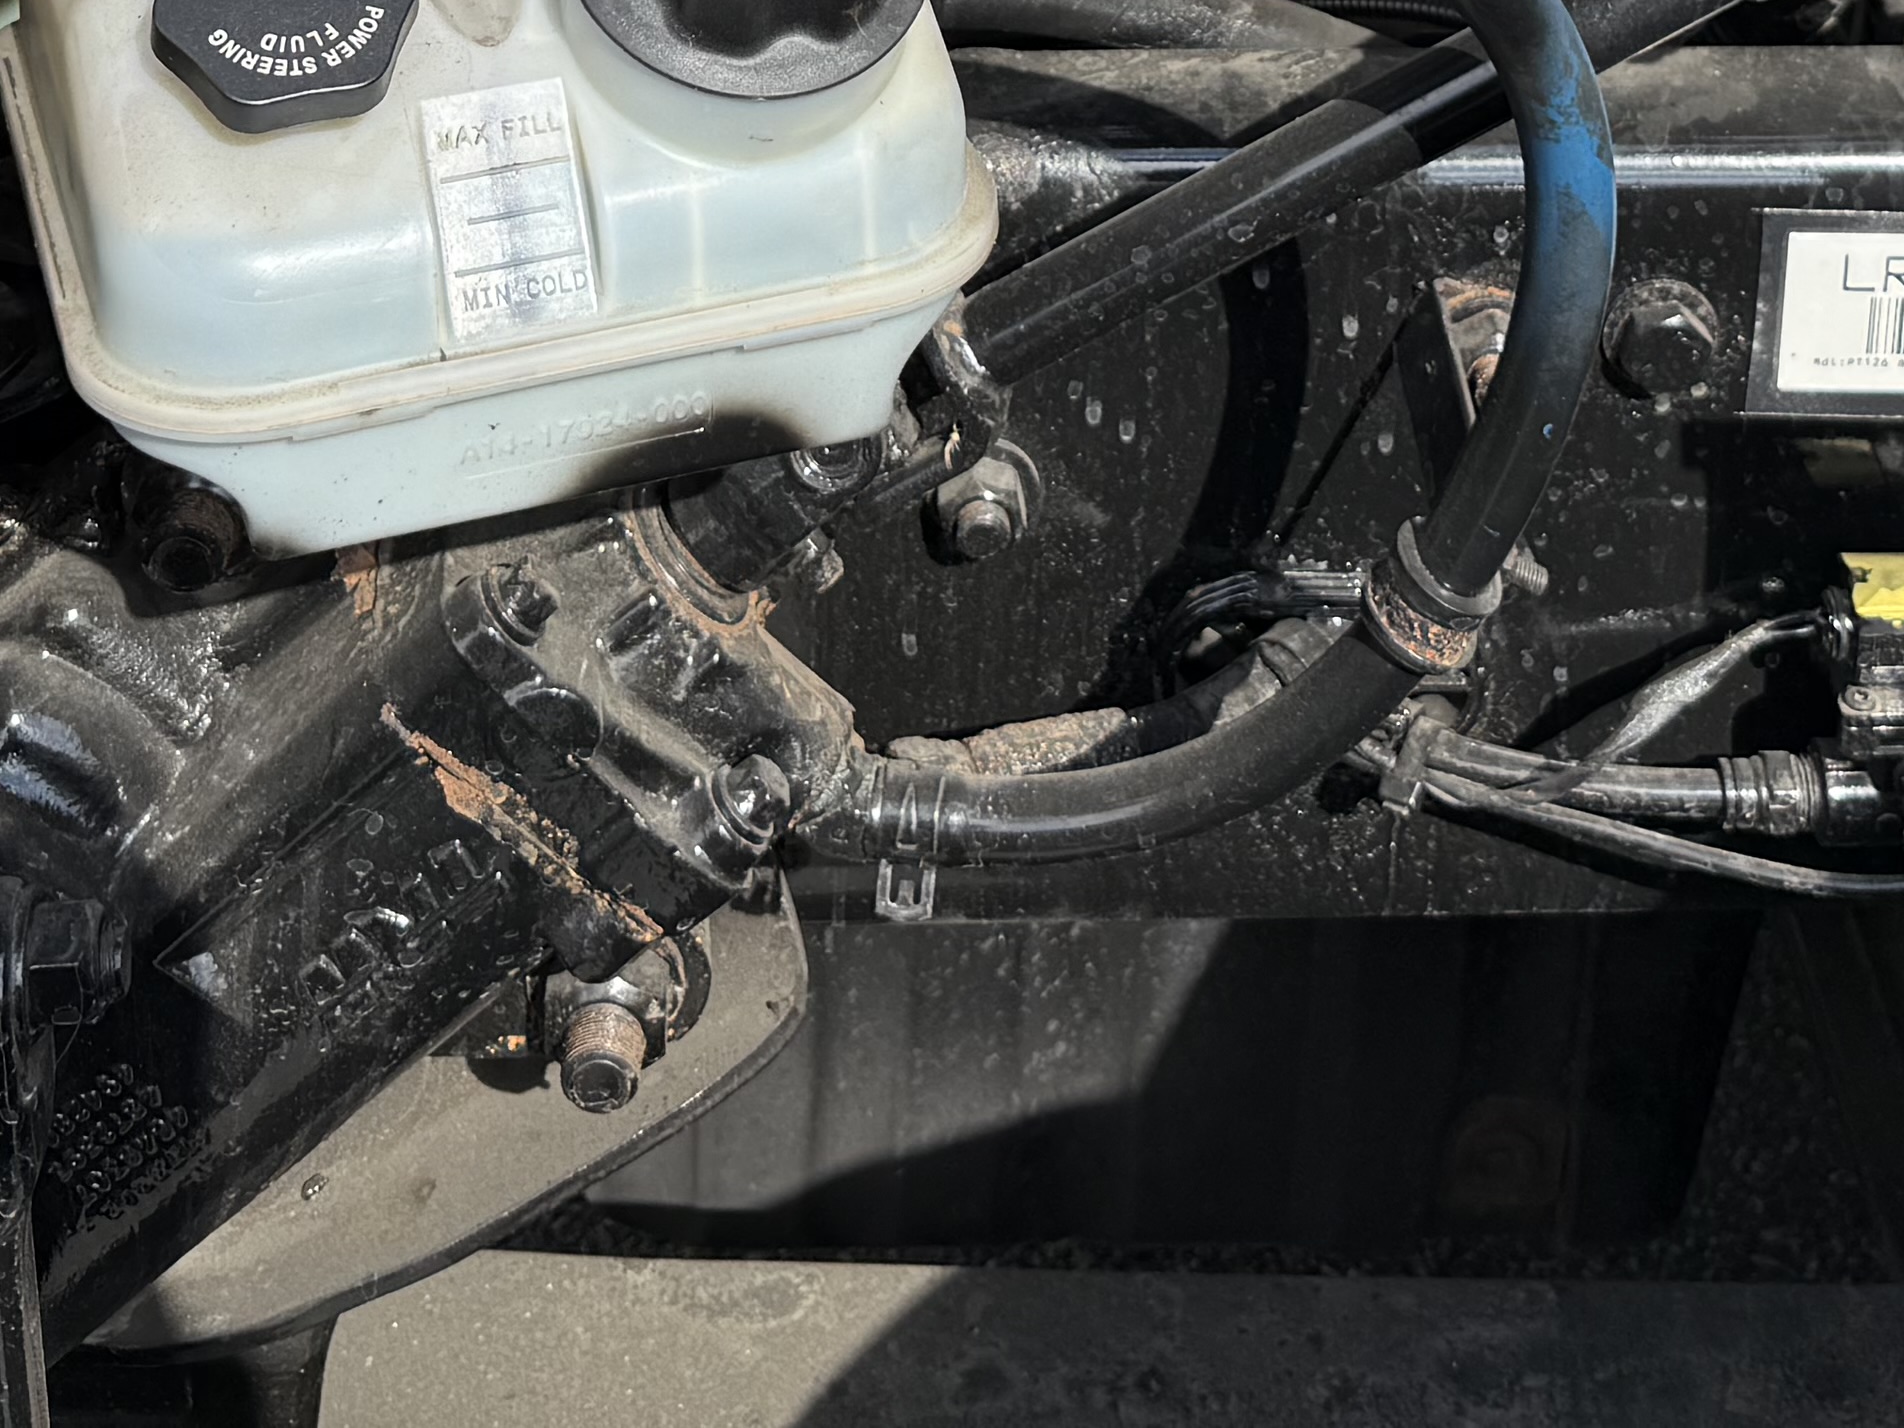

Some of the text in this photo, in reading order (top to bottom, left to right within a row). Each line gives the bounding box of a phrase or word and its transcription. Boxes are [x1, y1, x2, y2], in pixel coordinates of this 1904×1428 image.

[207, 5, 385, 77] POWER STEERING
[260, 22, 340, 53] FLUID
[434, 112, 563, 152] MAX FILL
[462, 269, 588, 312] MIN COLD
